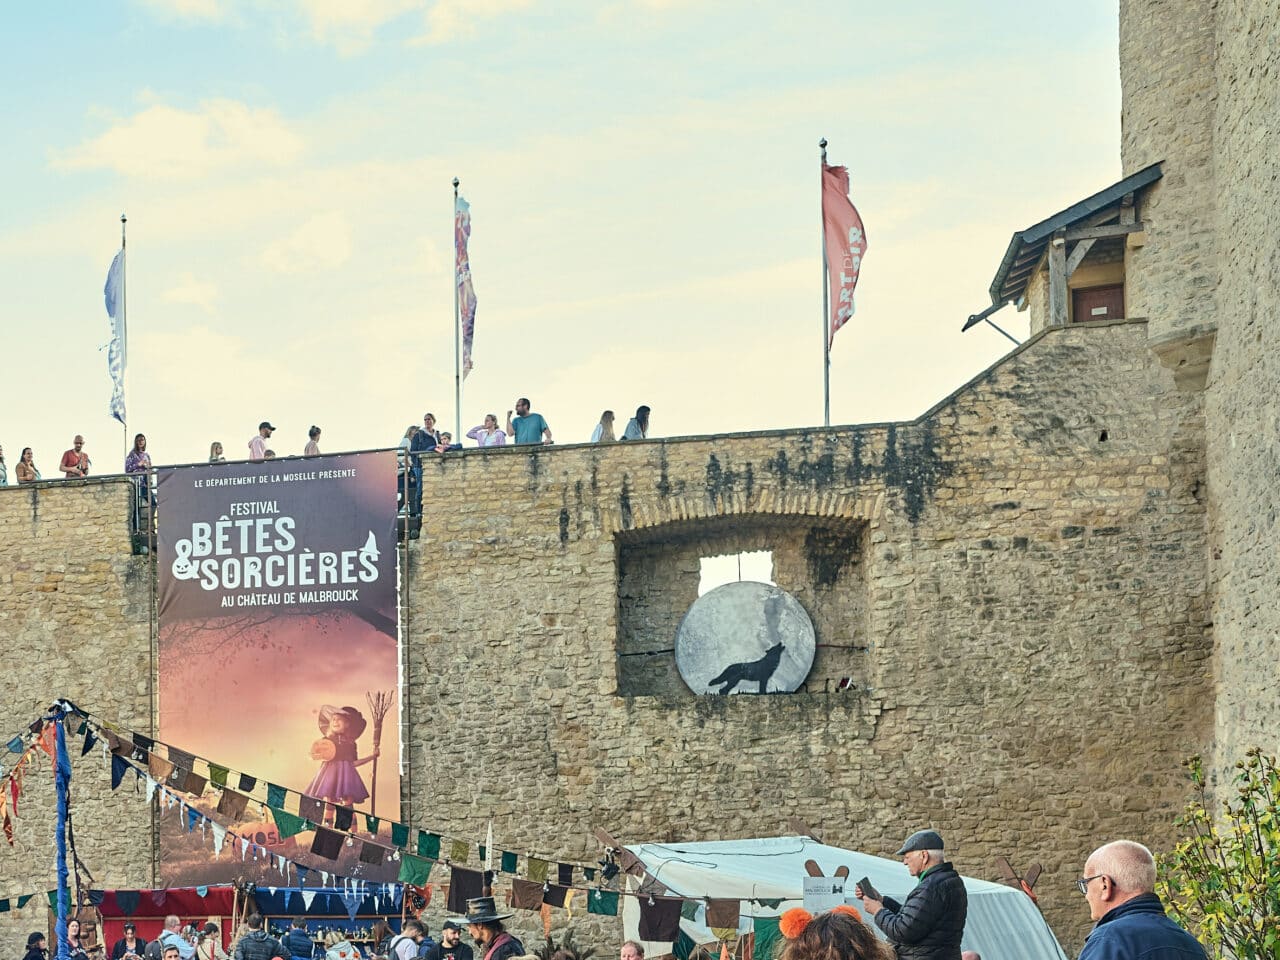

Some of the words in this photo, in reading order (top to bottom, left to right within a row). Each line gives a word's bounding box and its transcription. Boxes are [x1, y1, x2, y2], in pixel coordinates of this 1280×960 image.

[194, 480, 203, 488] LE
[206, 476, 256, 487] DÉPARTEMENT
[259, 475, 269, 484] DE
[271, 474, 281, 483] LA
[283, 471, 316, 481] MOSELLE
[319, 469, 356, 479] PRÉSENTE
[230, 501, 280, 516] FESTIVAL
[192, 515, 296, 557] BÊTES
[172, 538, 200, 580] &
[200, 548, 380, 591] SORCIÈRES
[221, 595, 234, 607] AU
[237, 592, 281, 606] CHÂTEAU
[284, 592, 296, 604] DE
[299, 589, 359, 603] MALBROUCK
